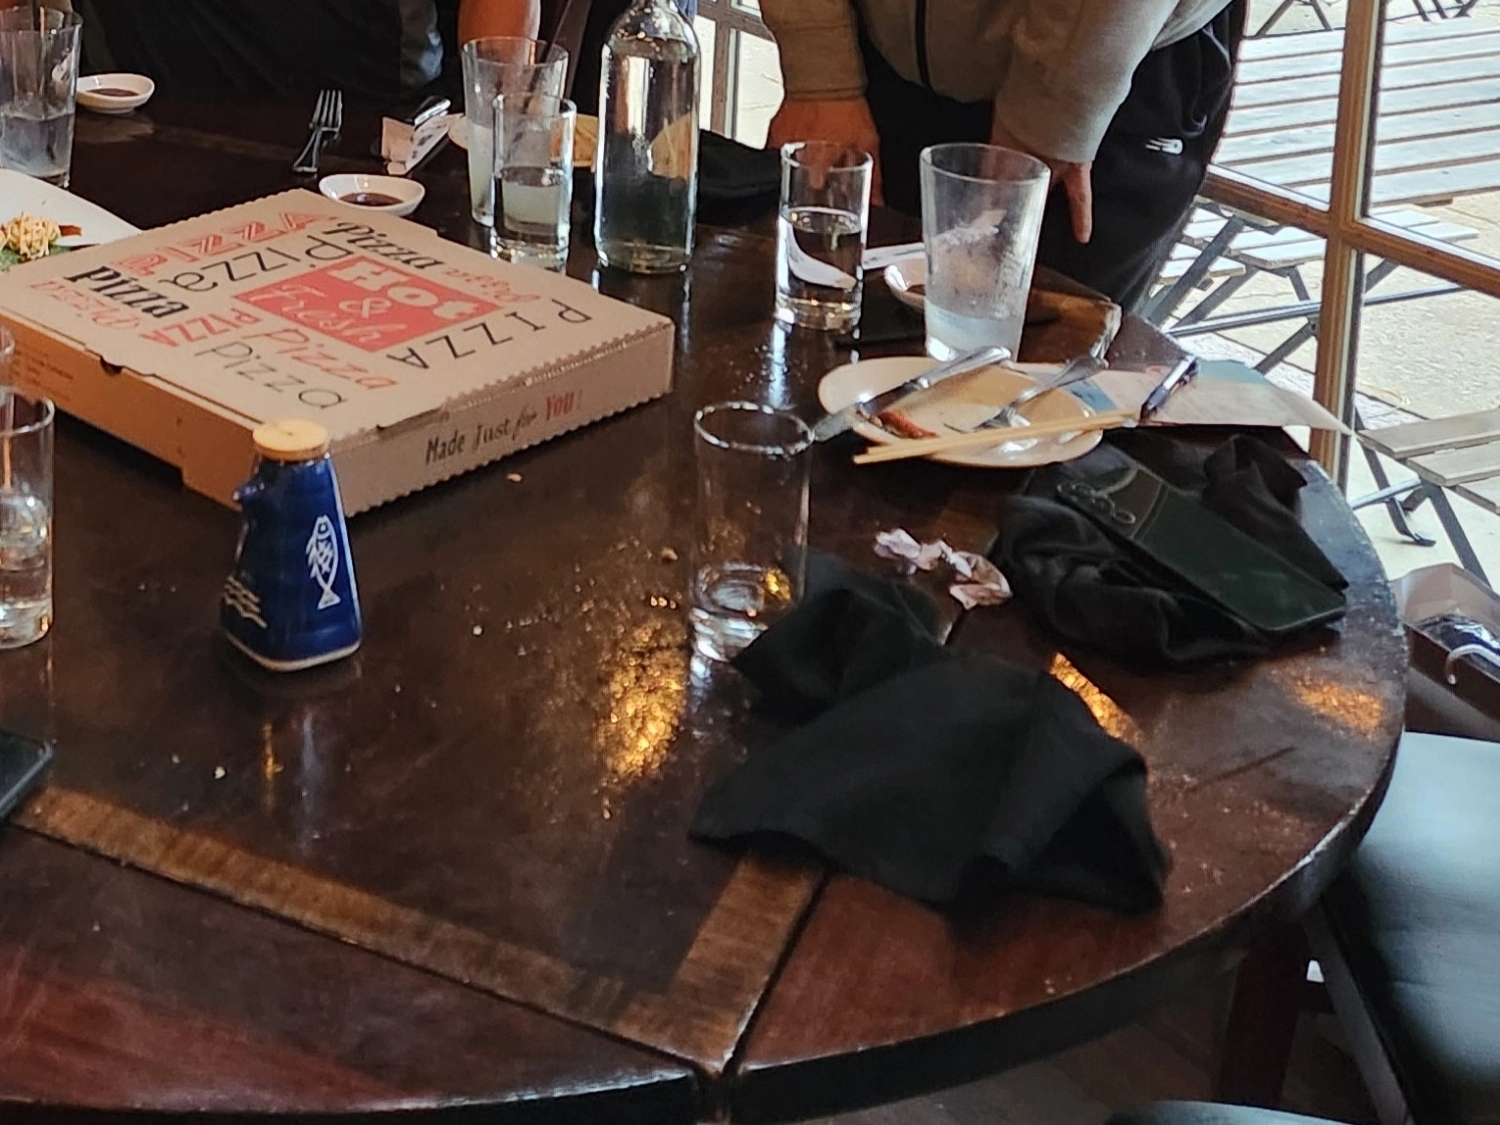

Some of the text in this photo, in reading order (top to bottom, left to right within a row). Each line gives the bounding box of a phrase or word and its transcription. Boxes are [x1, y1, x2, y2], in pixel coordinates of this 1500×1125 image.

[111, 211, 338, 277] PIZZA
[157, 234, 354, 293] Pizza
[322, 221, 446, 270] Pizza
[63, 265, 190, 319] Pizza
[248, 283, 408, 344] Fresh
[338, 296, 393, 319] &
[137, 307, 263, 348] PIZZA
[386, 298, 593, 370] PIZZA
[194, 340, 348, 409] Pizza
[240, 328, 398, 390] Pizza
[424, 429, 466, 466] Made
[472, 418, 510, 452] Just
